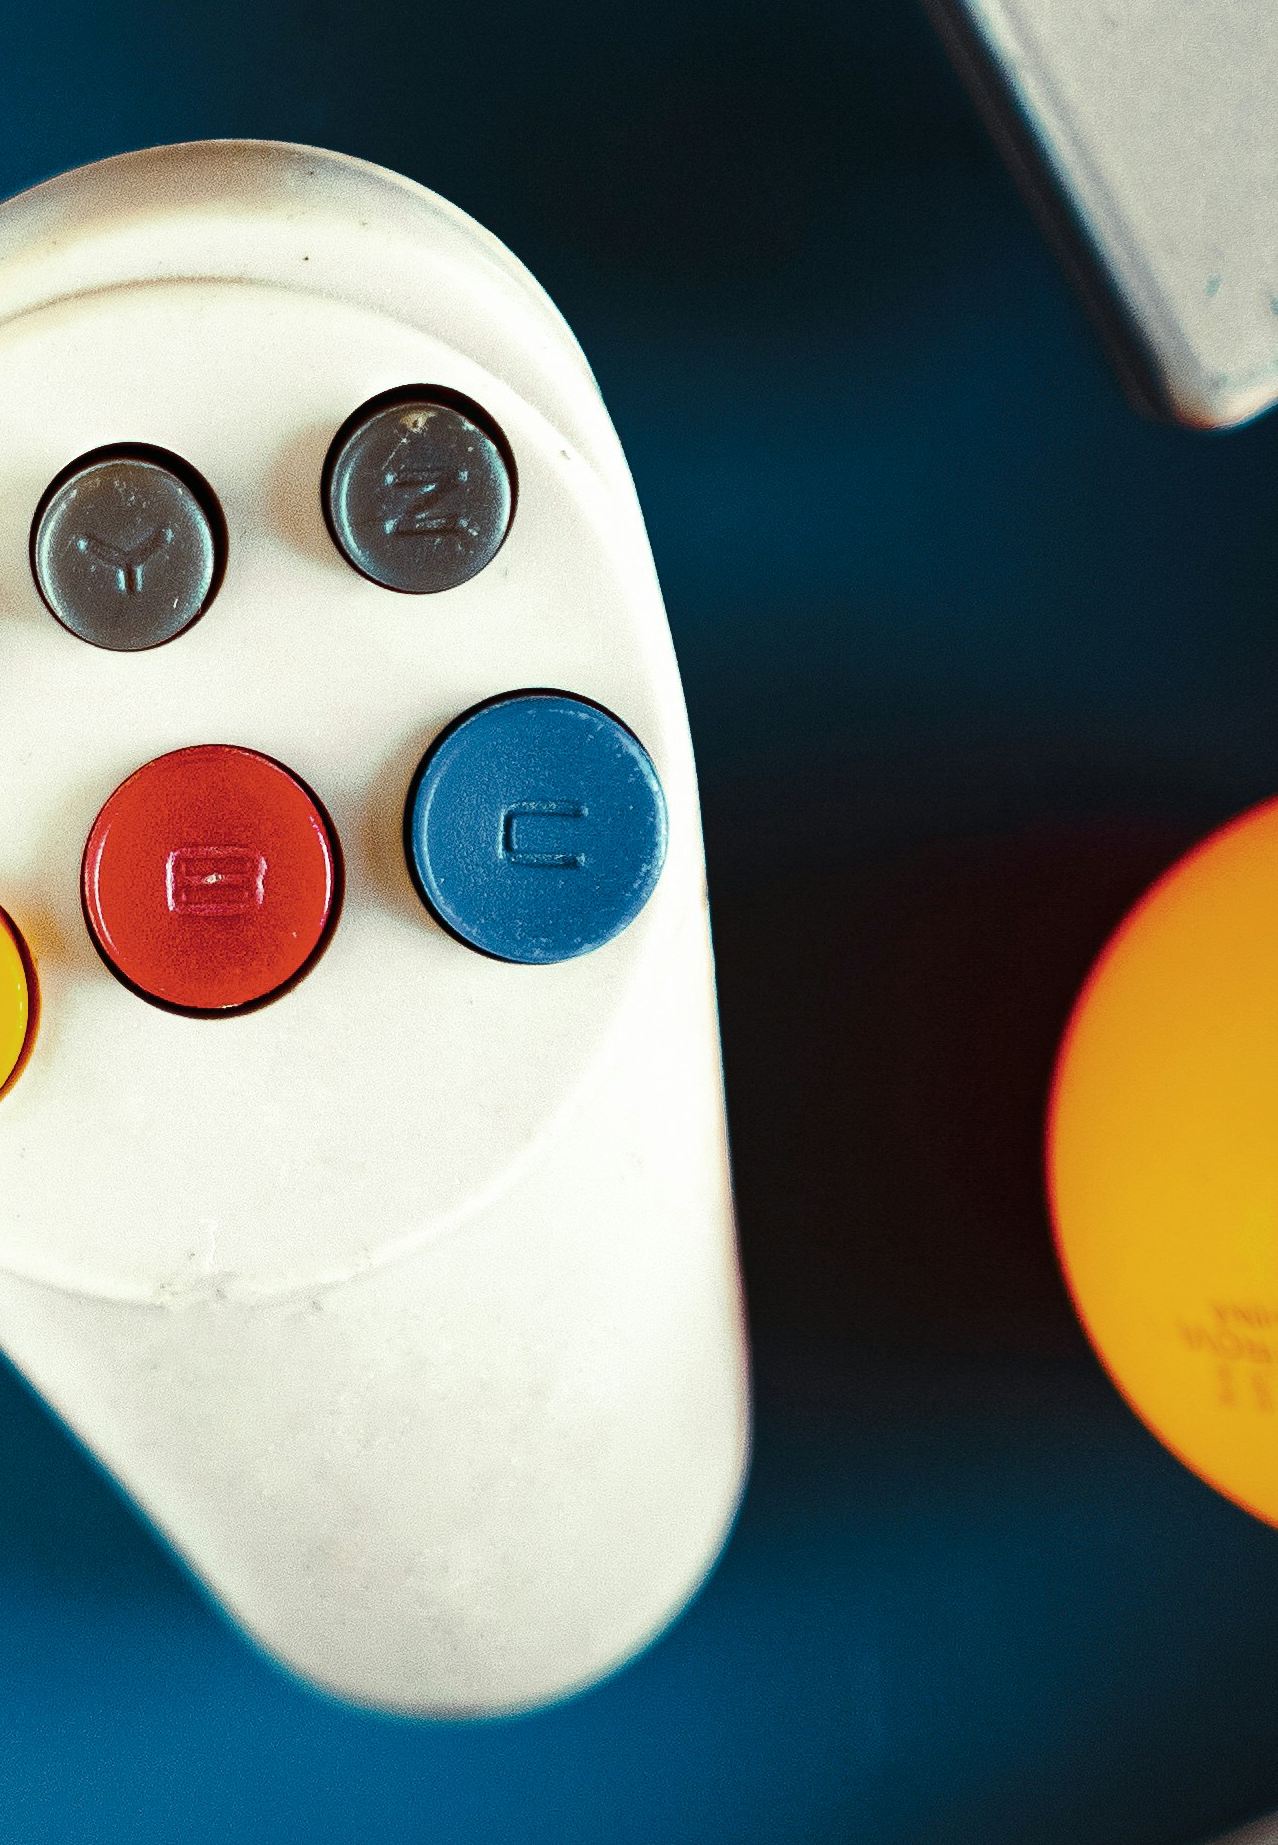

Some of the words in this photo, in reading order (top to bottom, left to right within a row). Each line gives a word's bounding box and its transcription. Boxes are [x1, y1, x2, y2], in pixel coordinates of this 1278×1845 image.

[76, 527, 175, 593] Y
[497, 797, 591, 870] C
[164, 844, 269, 917] B
